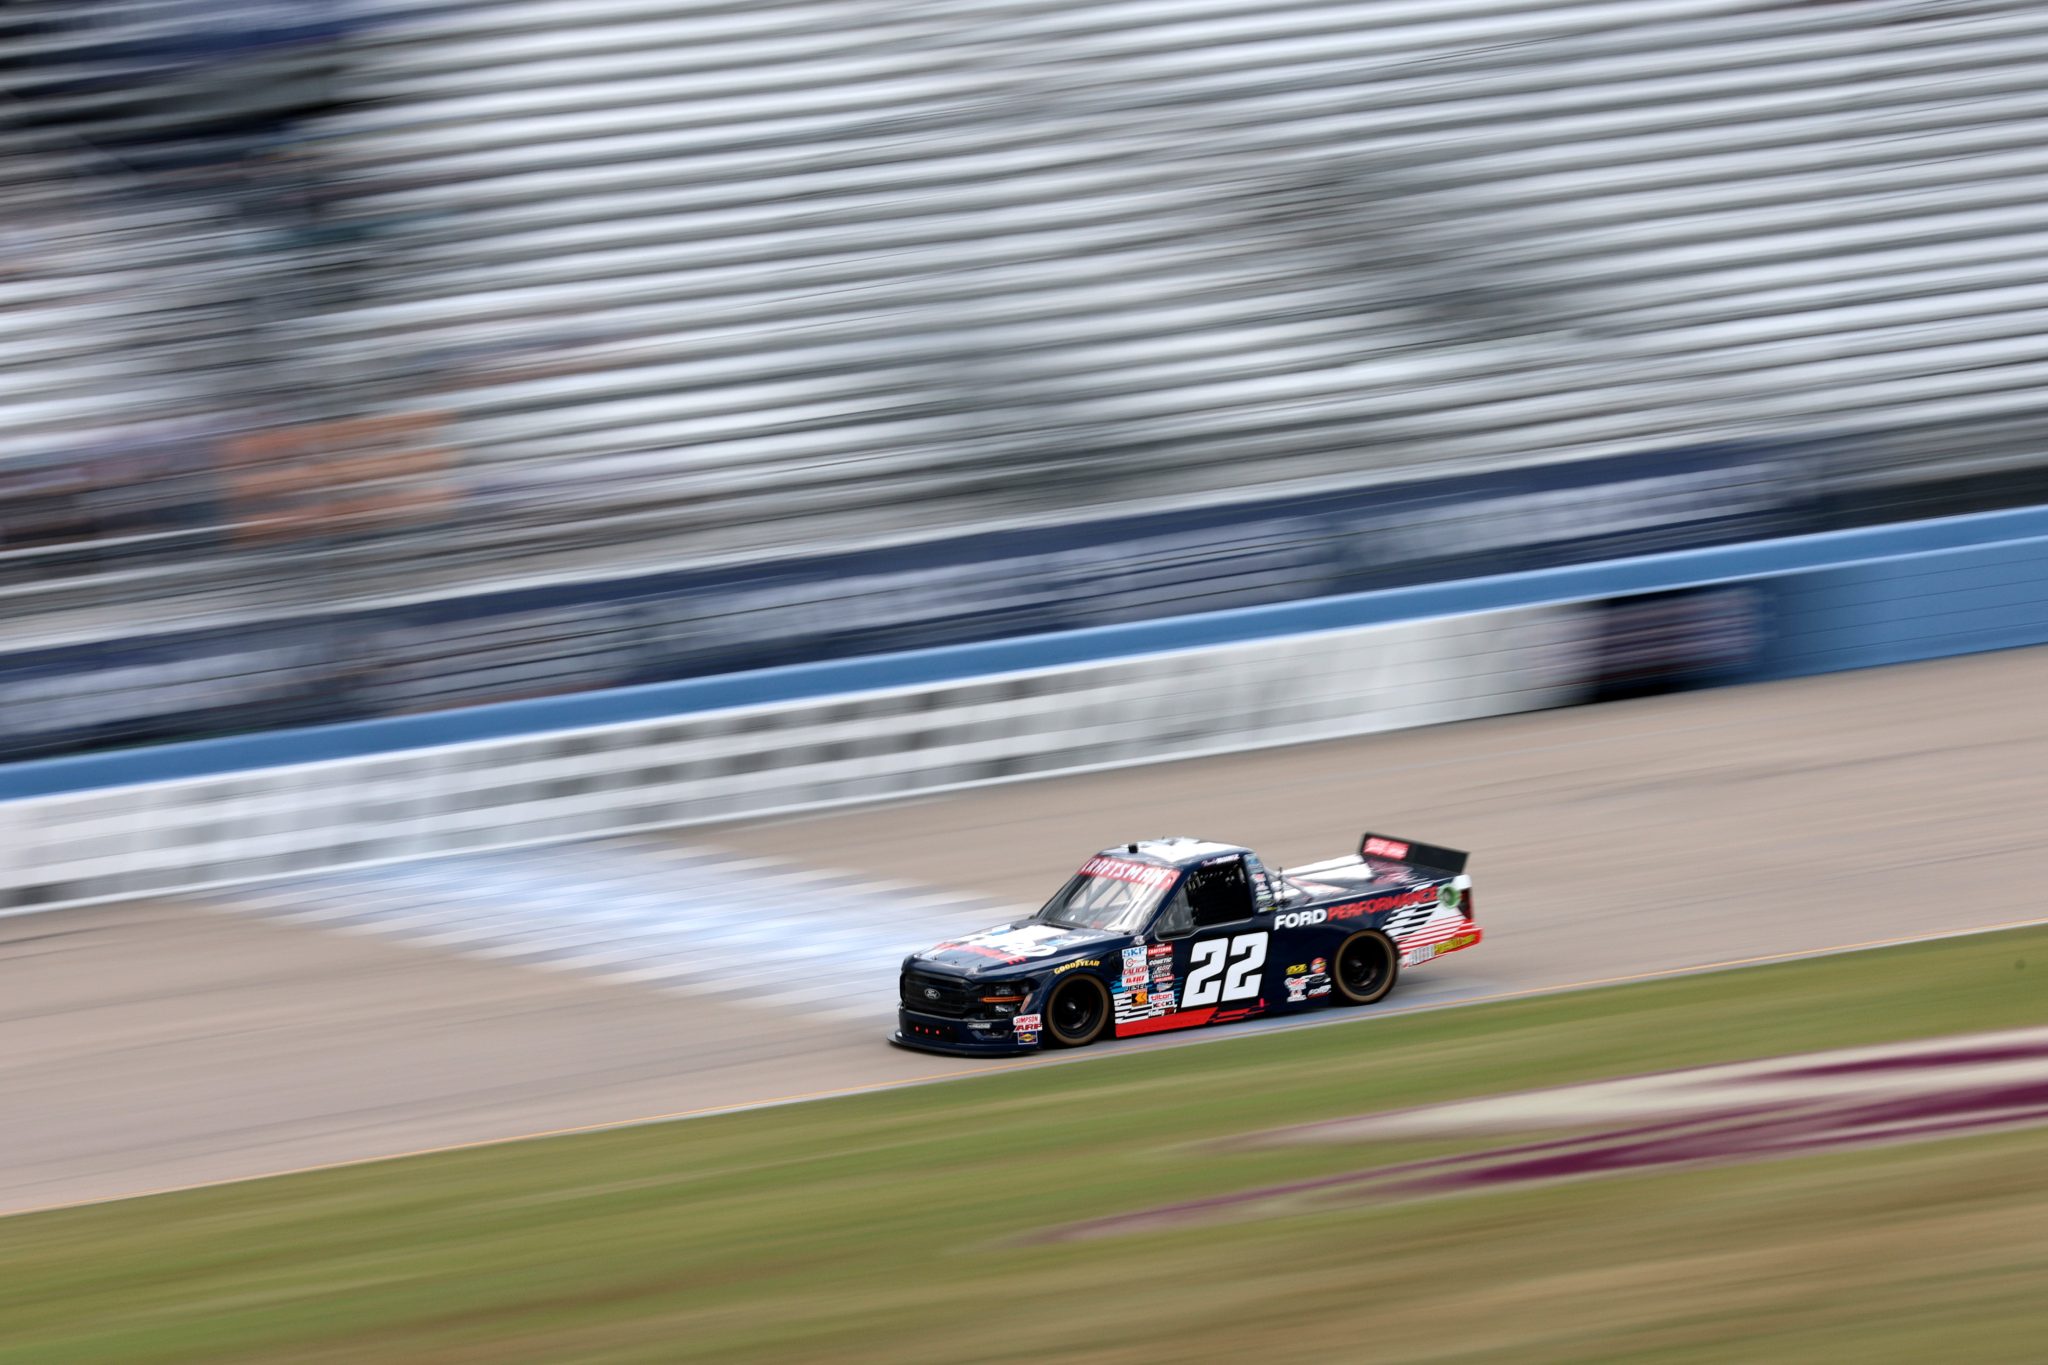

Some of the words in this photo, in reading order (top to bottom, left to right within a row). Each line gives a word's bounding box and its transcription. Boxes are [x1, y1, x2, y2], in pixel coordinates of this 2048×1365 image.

[1274, 909, 1327, 930] FORD
[1327, 886, 1439, 921] PERFORMANCE
[1054, 959, 1100, 974] GOODYEAR
[1181, 932, 1268, 1008] 22
[1015, 1015, 1039, 1024] SIMPSON
[1015, 1023, 1042, 1032] ARP
